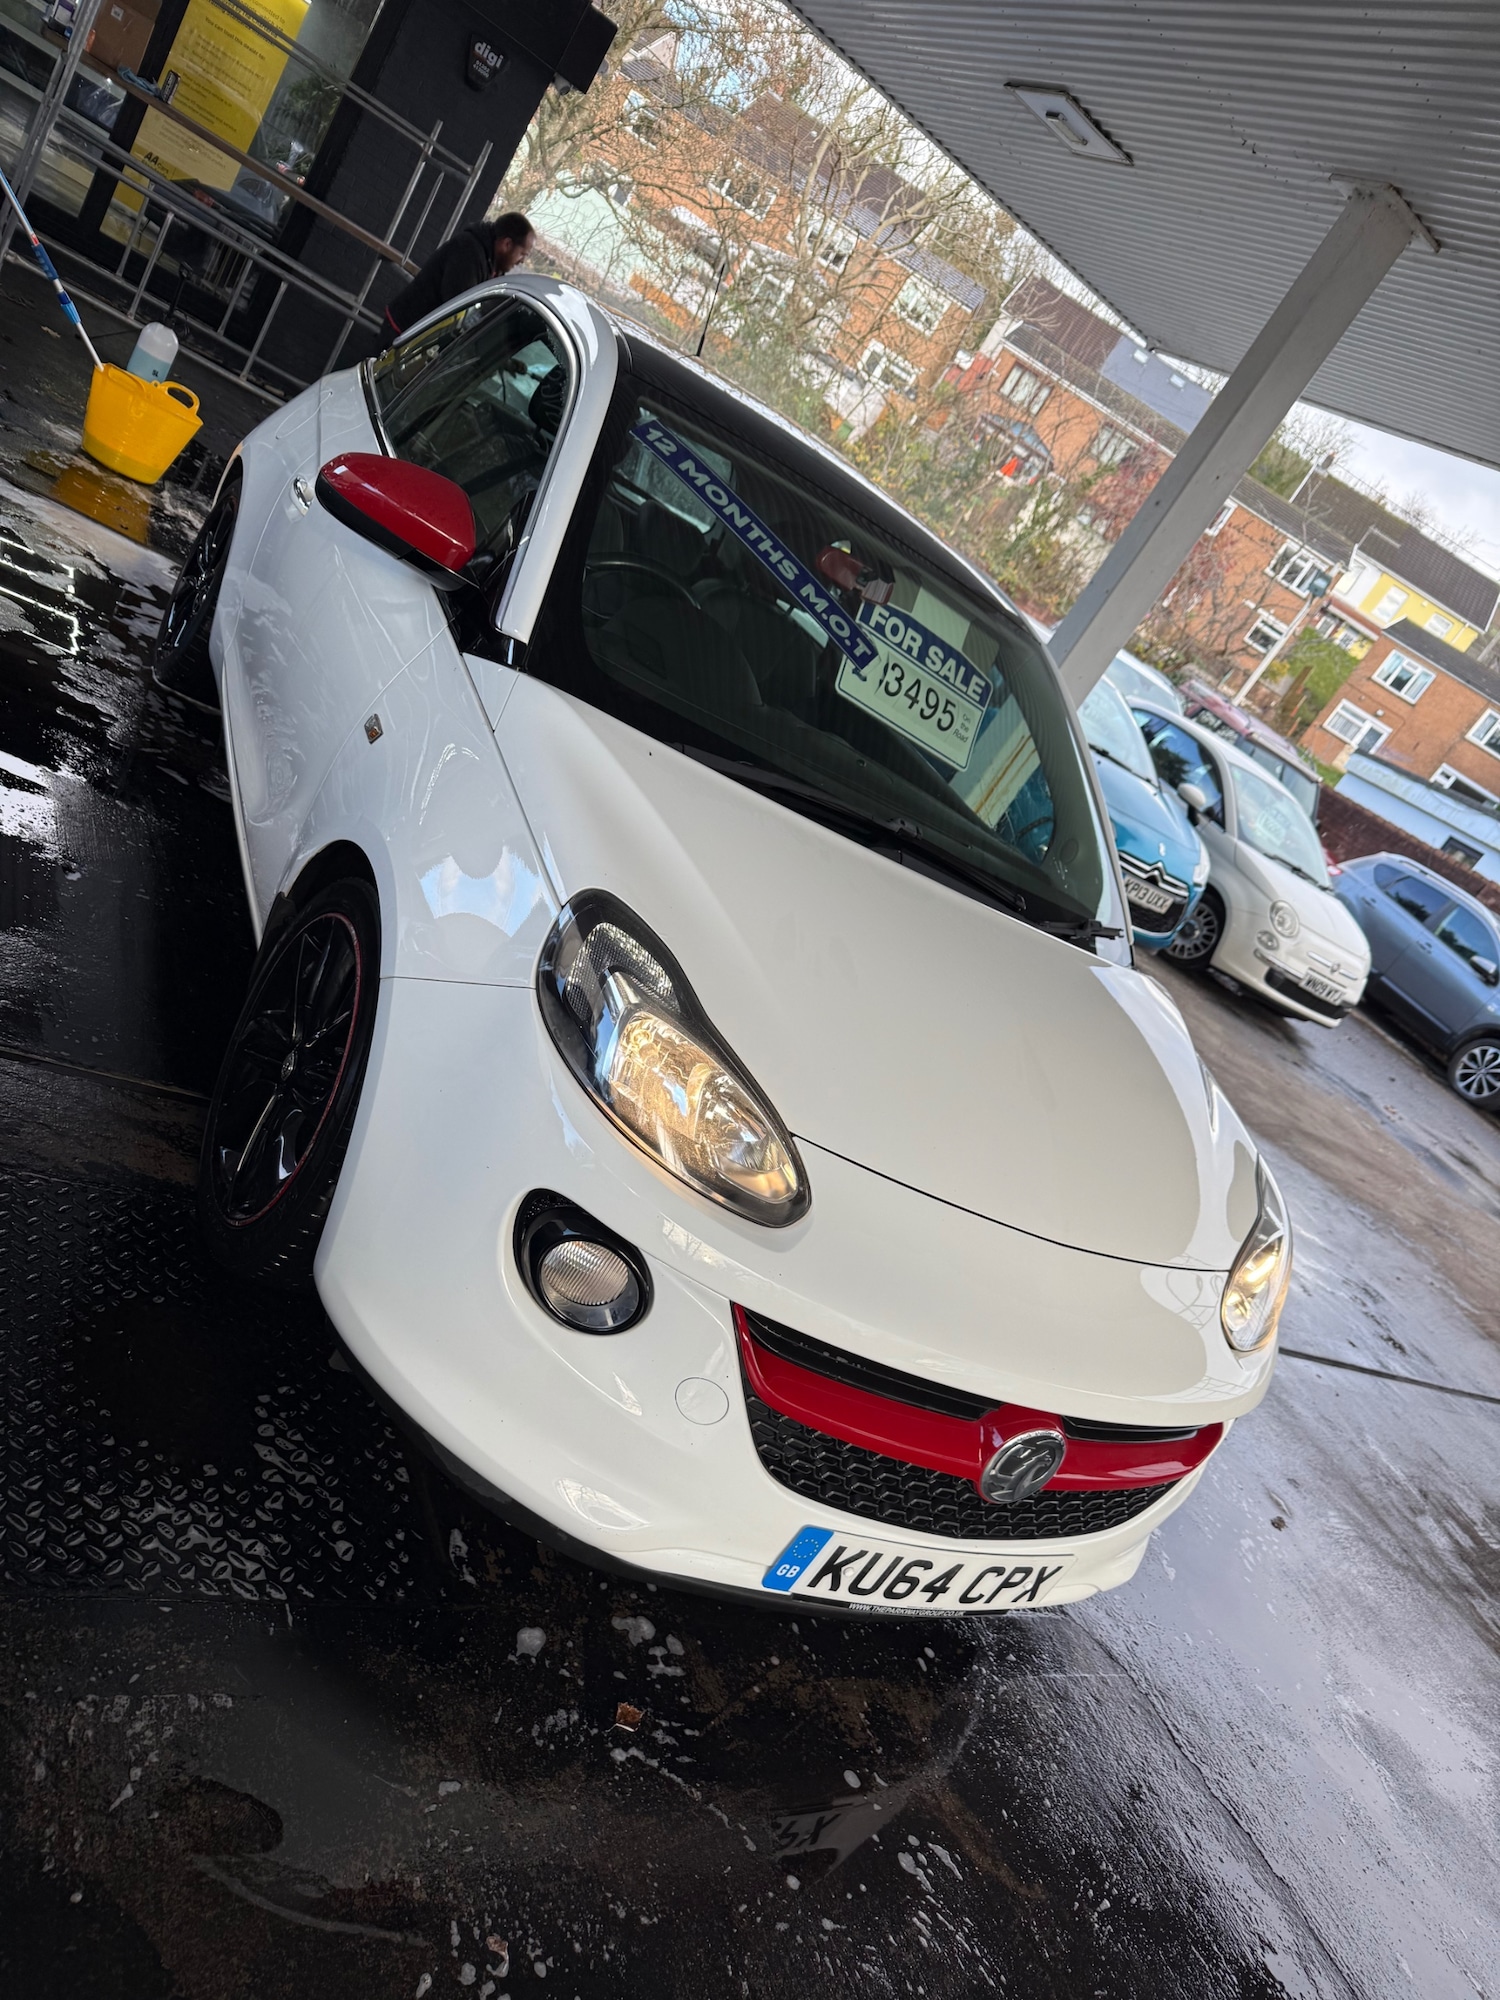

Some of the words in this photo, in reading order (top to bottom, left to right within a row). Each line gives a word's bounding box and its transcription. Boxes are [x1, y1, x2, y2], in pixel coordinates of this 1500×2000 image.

[475, 42, 504, 68] digi
[144, 151, 160, 165] AA
[646, 427, 678, 457] 12
[678, 458, 800, 581] MONTHS
[800, 583, 872, 657] M.O.T
[869, 604, 923, 658] FOR
[925, 645, 986, 702] SALE
[952, 728, 969, 743] Road
[776, 1563, 801, 1578] GB
[807, 1545, 965, 1602] KU64
[958, 1566, 1064, 1604] CPX
